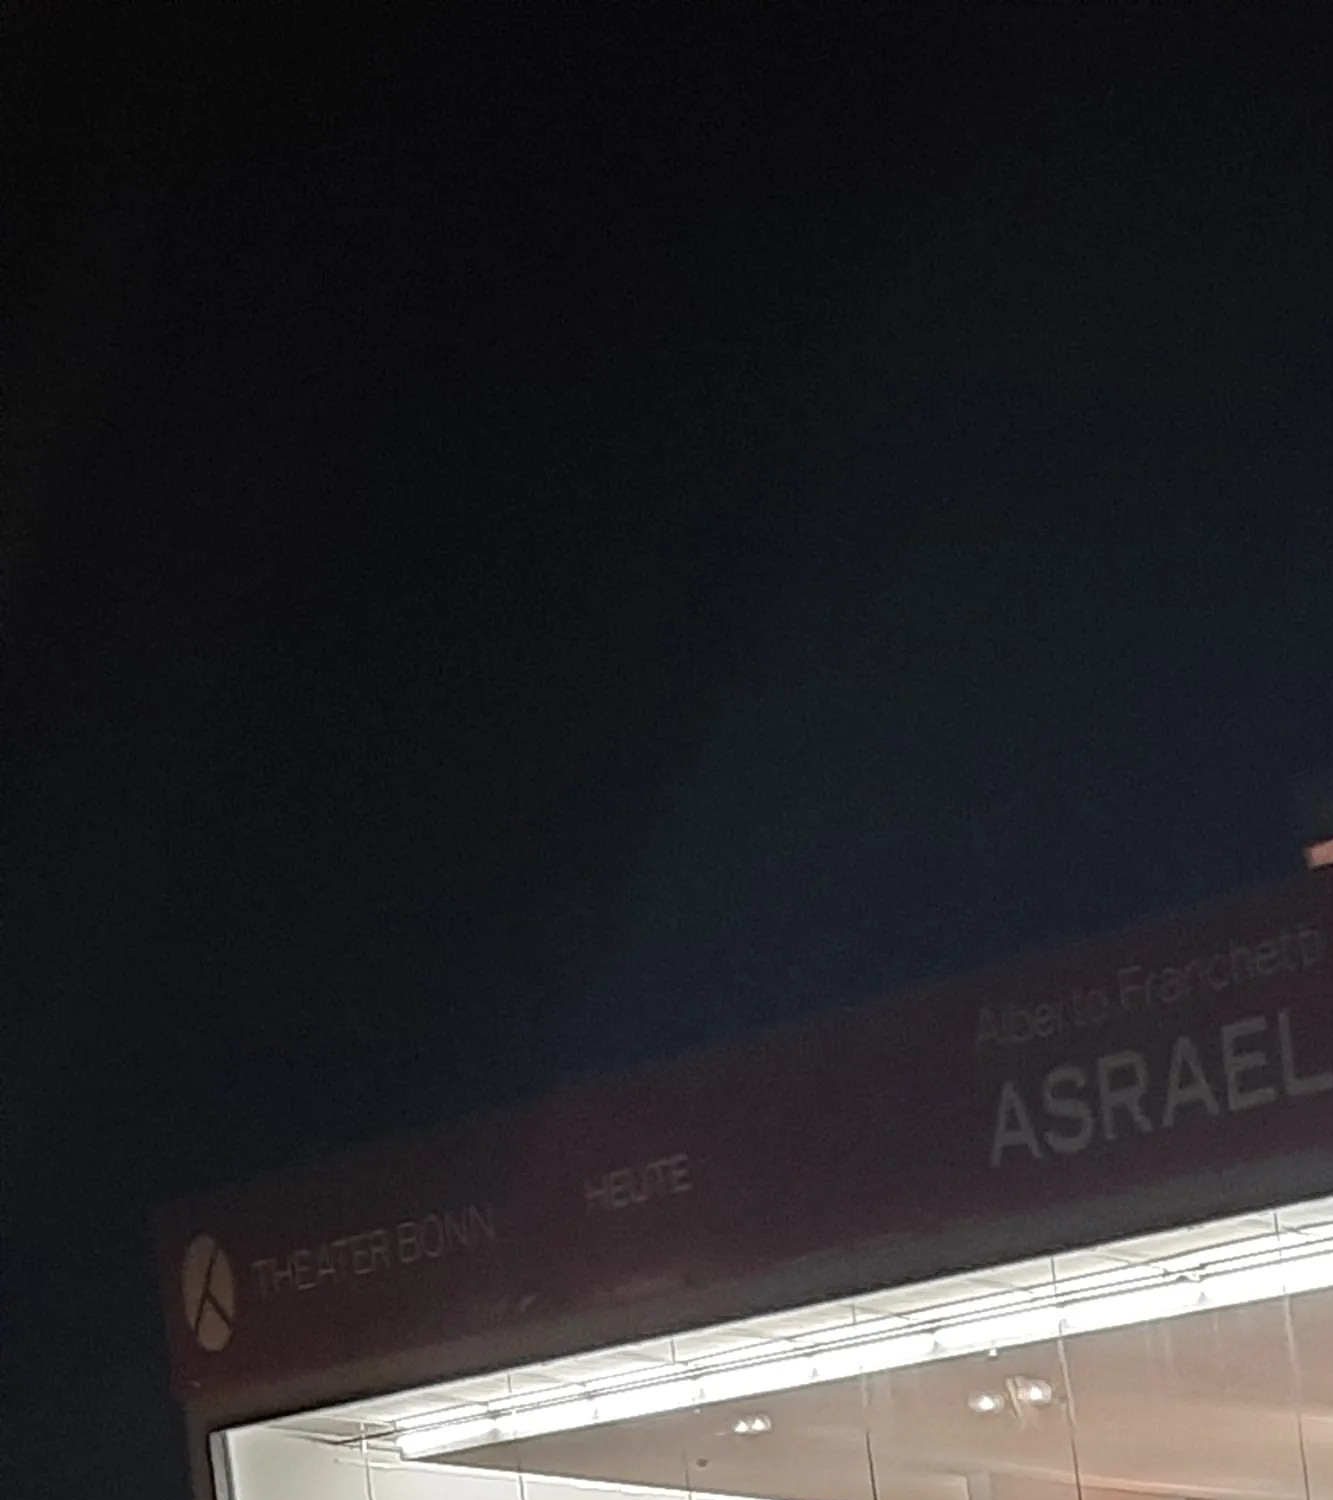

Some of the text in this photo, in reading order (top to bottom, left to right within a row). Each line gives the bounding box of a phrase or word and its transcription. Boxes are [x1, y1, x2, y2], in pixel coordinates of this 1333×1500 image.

[1116, 922, 1325, 1010] Franchetti
[250, 1202, 498, 1300] THEATER BONN
